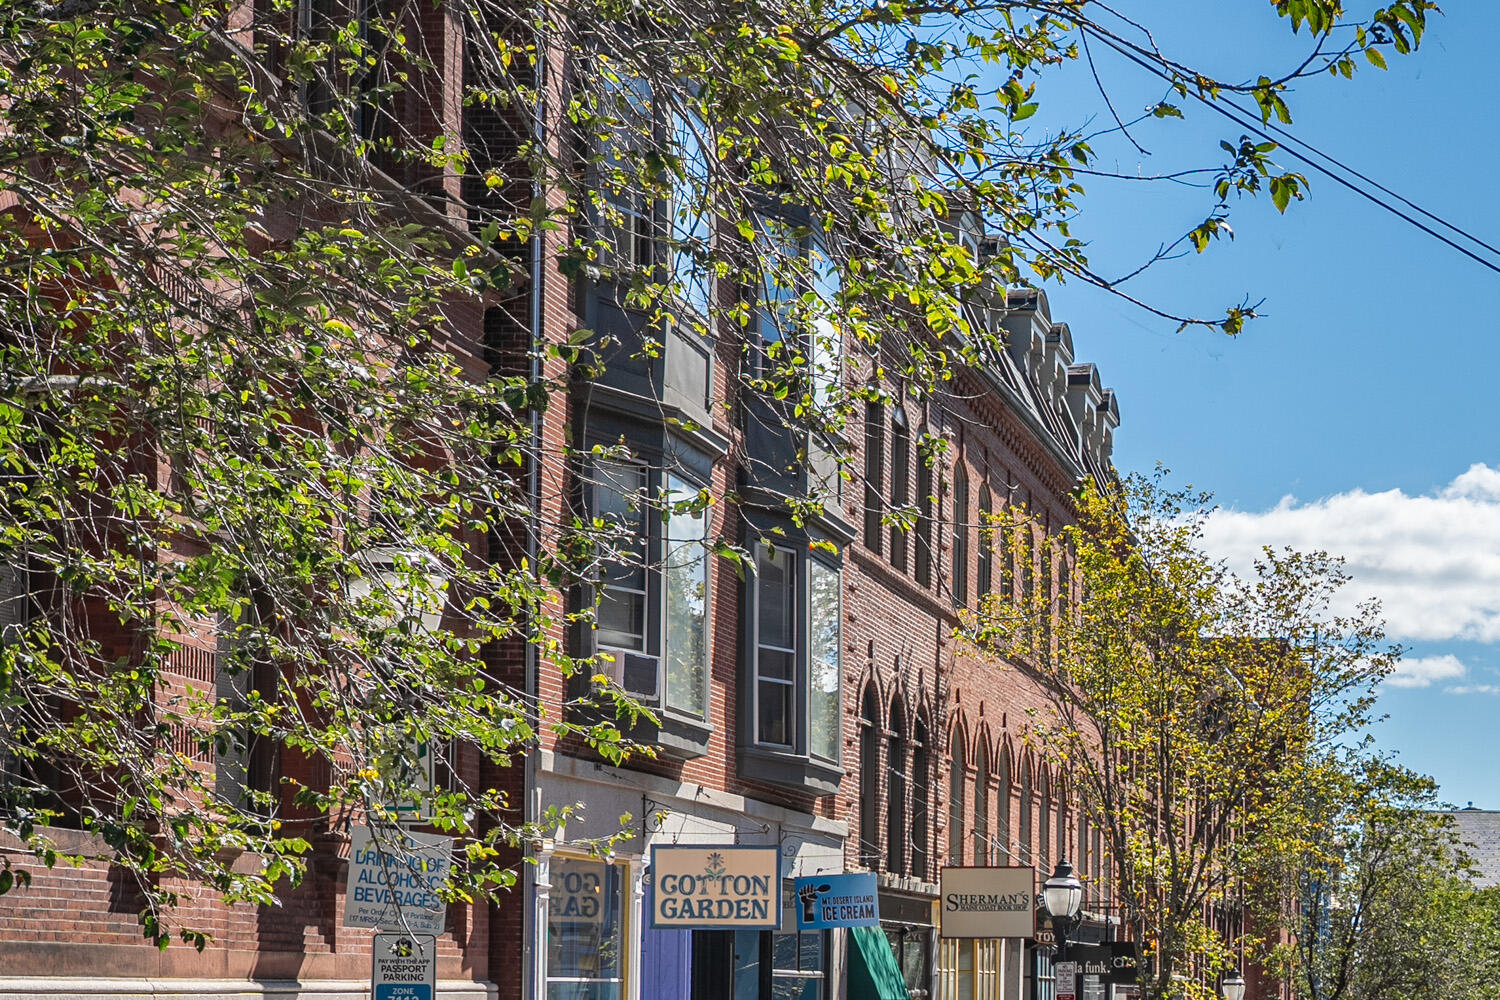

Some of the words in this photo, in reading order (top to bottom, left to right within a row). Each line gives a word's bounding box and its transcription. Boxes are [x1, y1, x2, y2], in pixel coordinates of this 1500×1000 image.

[660, 874, 771, 896] COTTON
[354, 886, 440, 908] BEVERAGES
[833, 896, 853, 905] DESERT
[854, 895, 874, 904] ISLAND
[946, 892, 1029, 912] SHERMAN'S
[660, 898, 770, 920] GARDEN
[822, 906, 838, 921] ICE
[841, 904, 874, 920] CREAM
[1036, 932, 1056, 942] TOY
[1085, 961, 1111, 973] funk.
